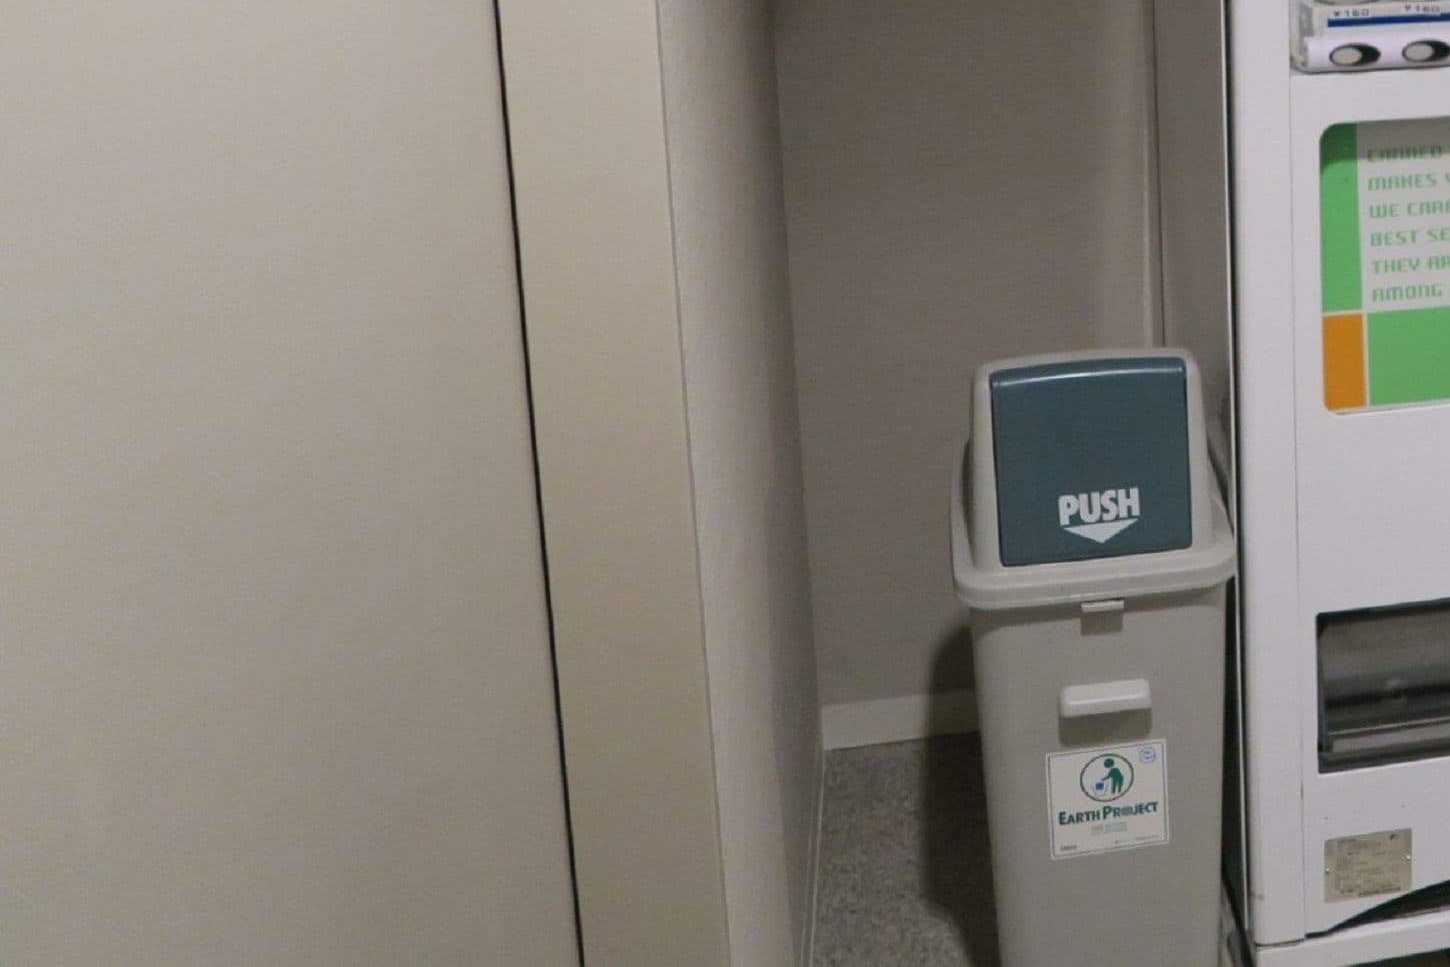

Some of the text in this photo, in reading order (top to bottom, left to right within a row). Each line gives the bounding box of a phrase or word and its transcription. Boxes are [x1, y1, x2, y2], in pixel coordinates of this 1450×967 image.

[1368, 173, 1437, 191] MAKES
[1369, 202, 1399, 218] WE
[1370, 230, 1418, 247] BEST
[1372, 257, 1420, 274] THEY
[1372, 284, 1442, 302] AMONG
[1058, 487, 1141, 526] PUSH
